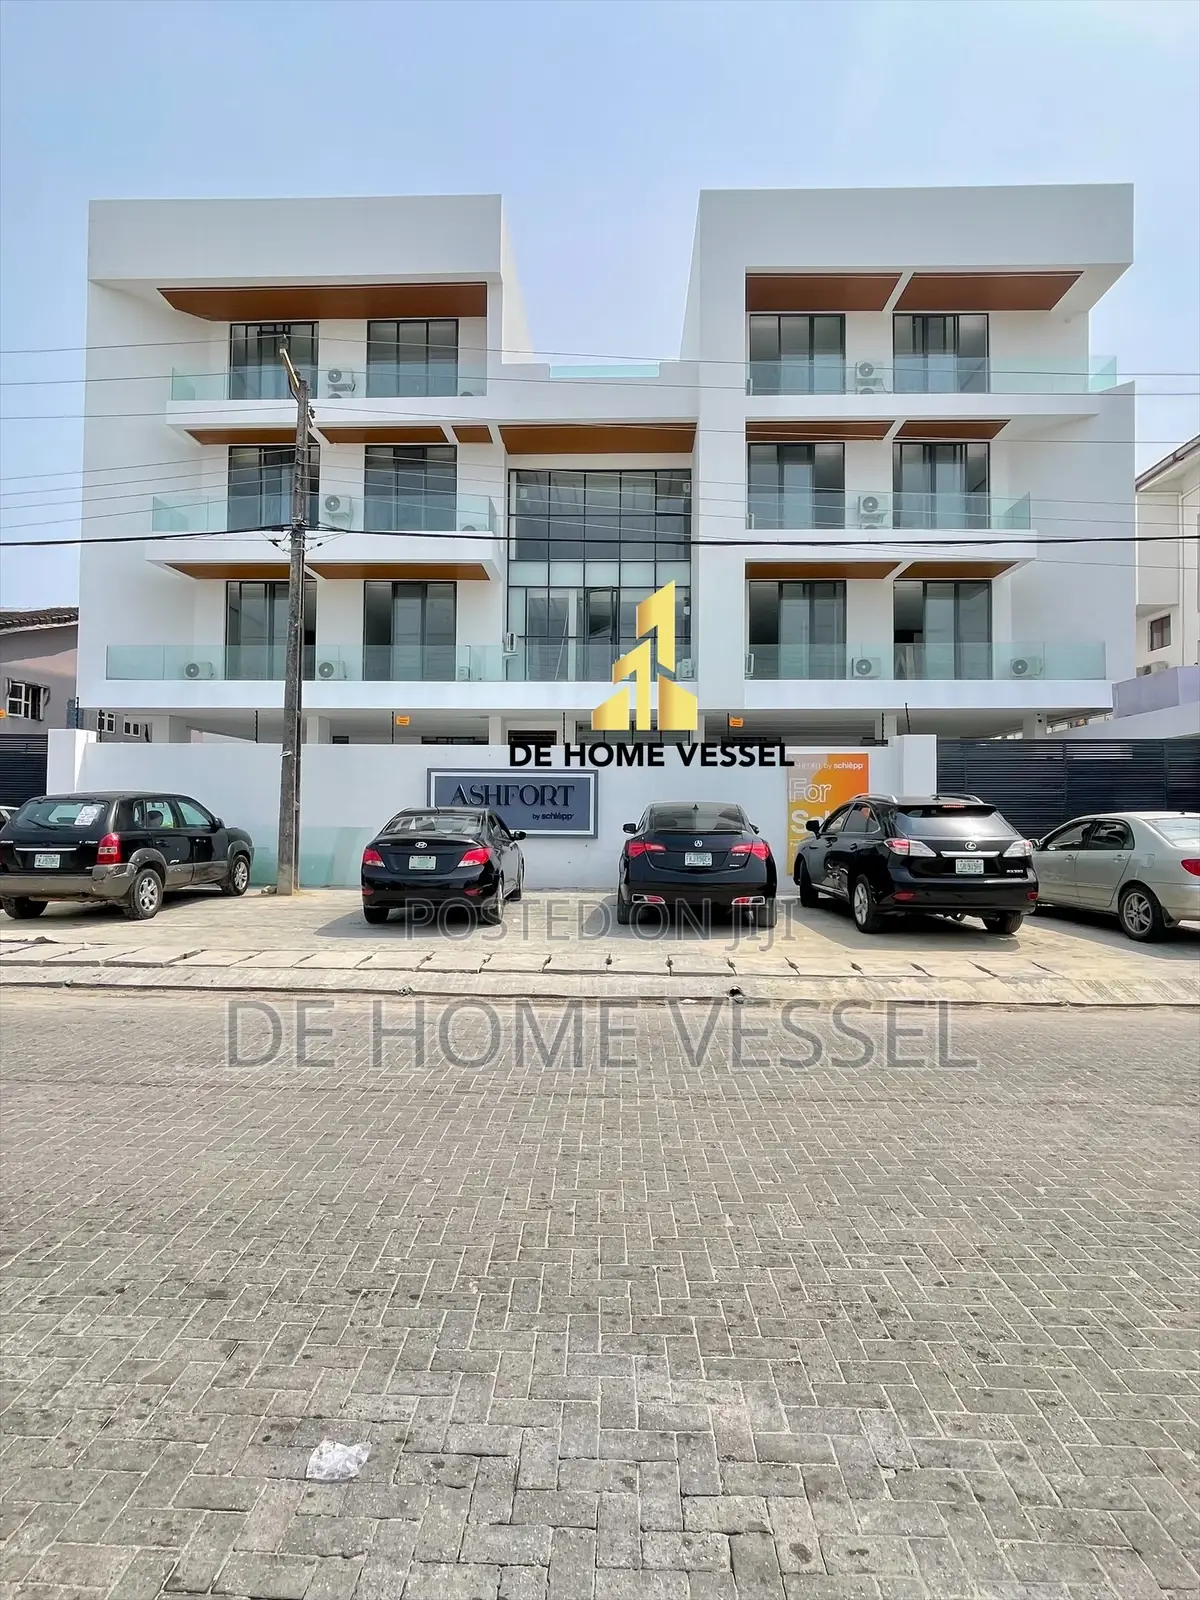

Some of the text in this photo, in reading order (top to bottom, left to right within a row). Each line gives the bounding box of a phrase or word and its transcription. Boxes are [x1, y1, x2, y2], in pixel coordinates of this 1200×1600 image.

[450, 784, 575, 806] ASHFORT
[789, 778, 832, 803] For
[532, 813, 541, 821] by
